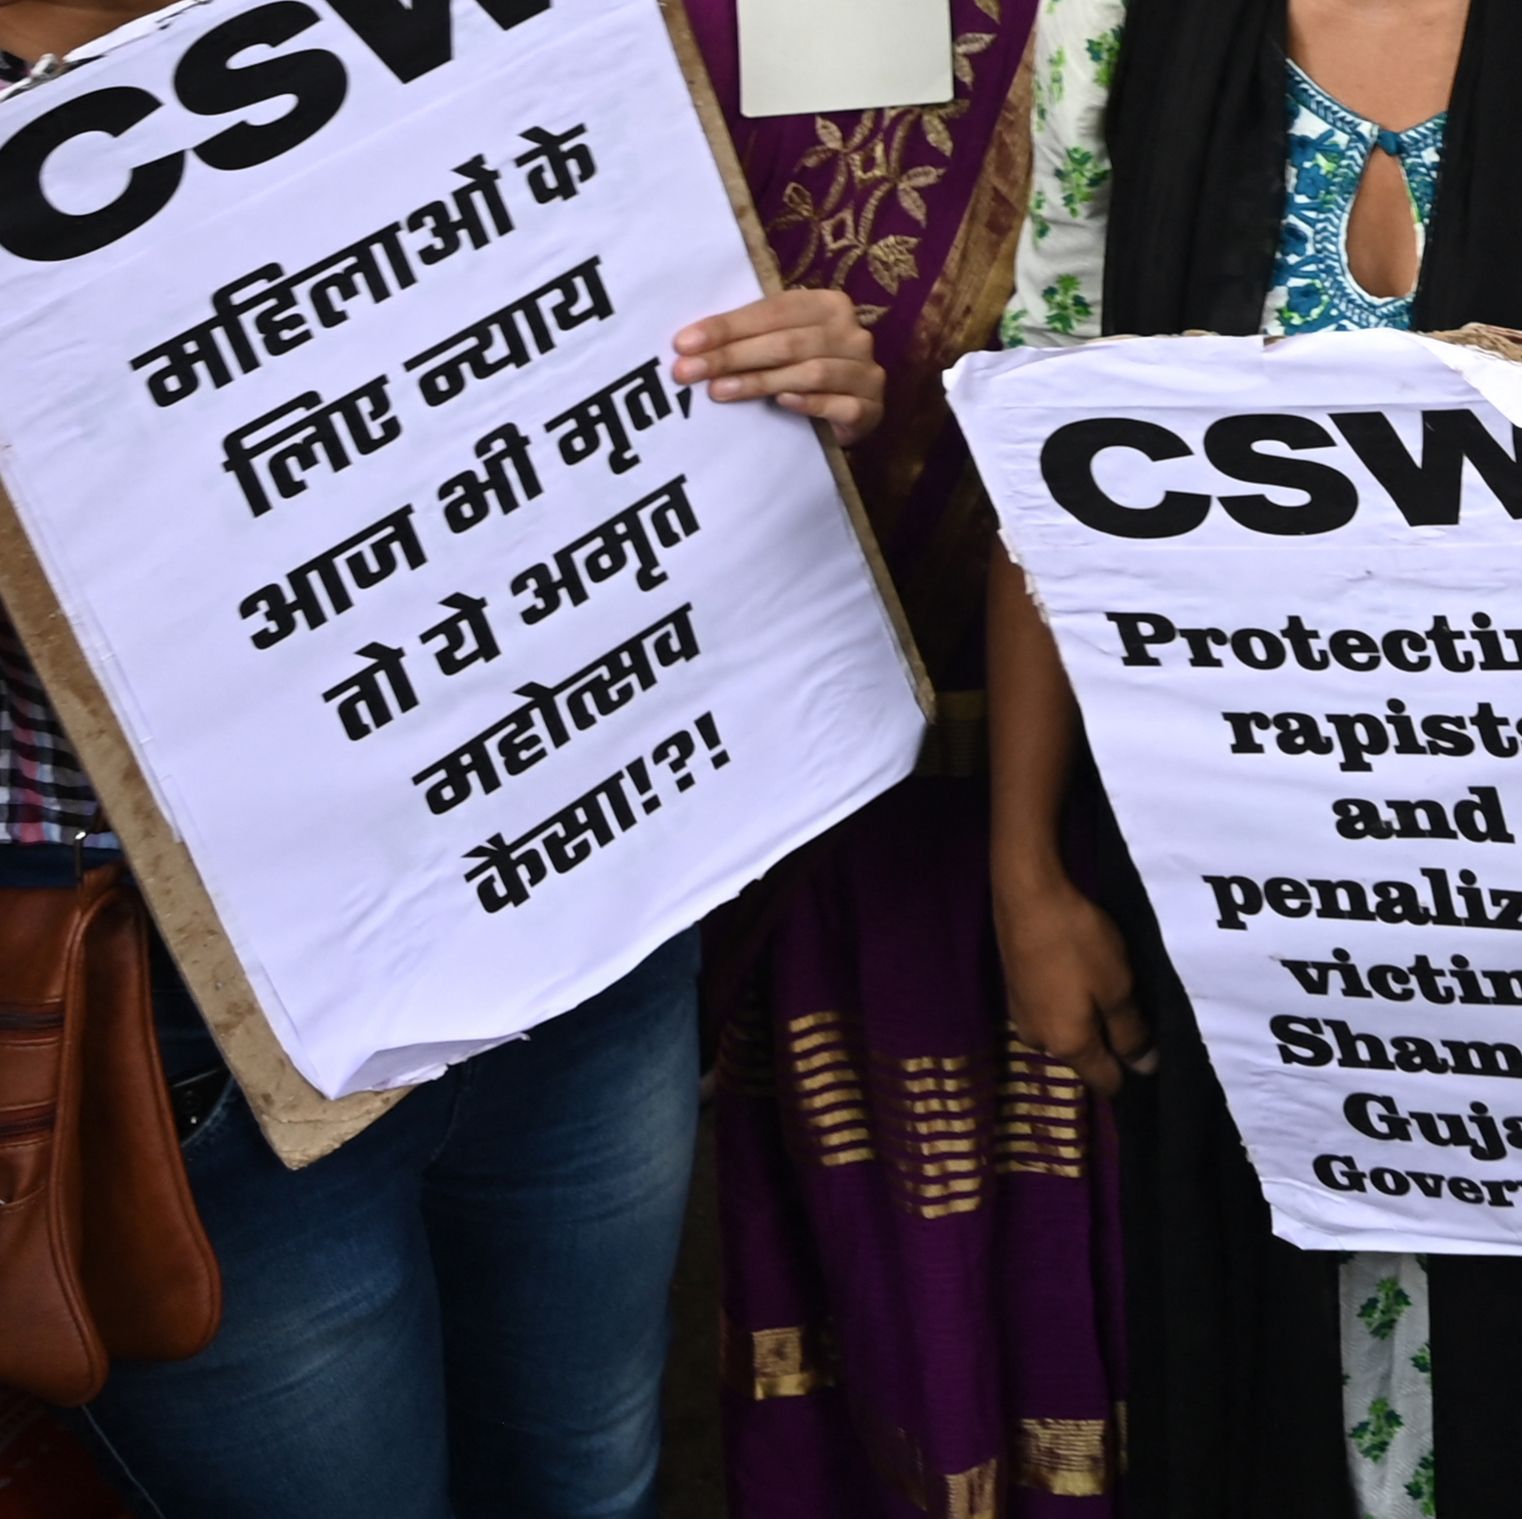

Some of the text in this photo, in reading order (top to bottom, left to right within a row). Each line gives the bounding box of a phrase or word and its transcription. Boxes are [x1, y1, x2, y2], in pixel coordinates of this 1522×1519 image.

[130, 124, 595, 407] महिलाओं के
[223, 256, 614, 517] लिए न्याय
[239, 357, 694, 649] आज भी मृत,
[322, 474, 699, 741] तो ये अमृत
[412, 595, 700, 815] महोत्सव
[1332, 786, 1515, 843] and
